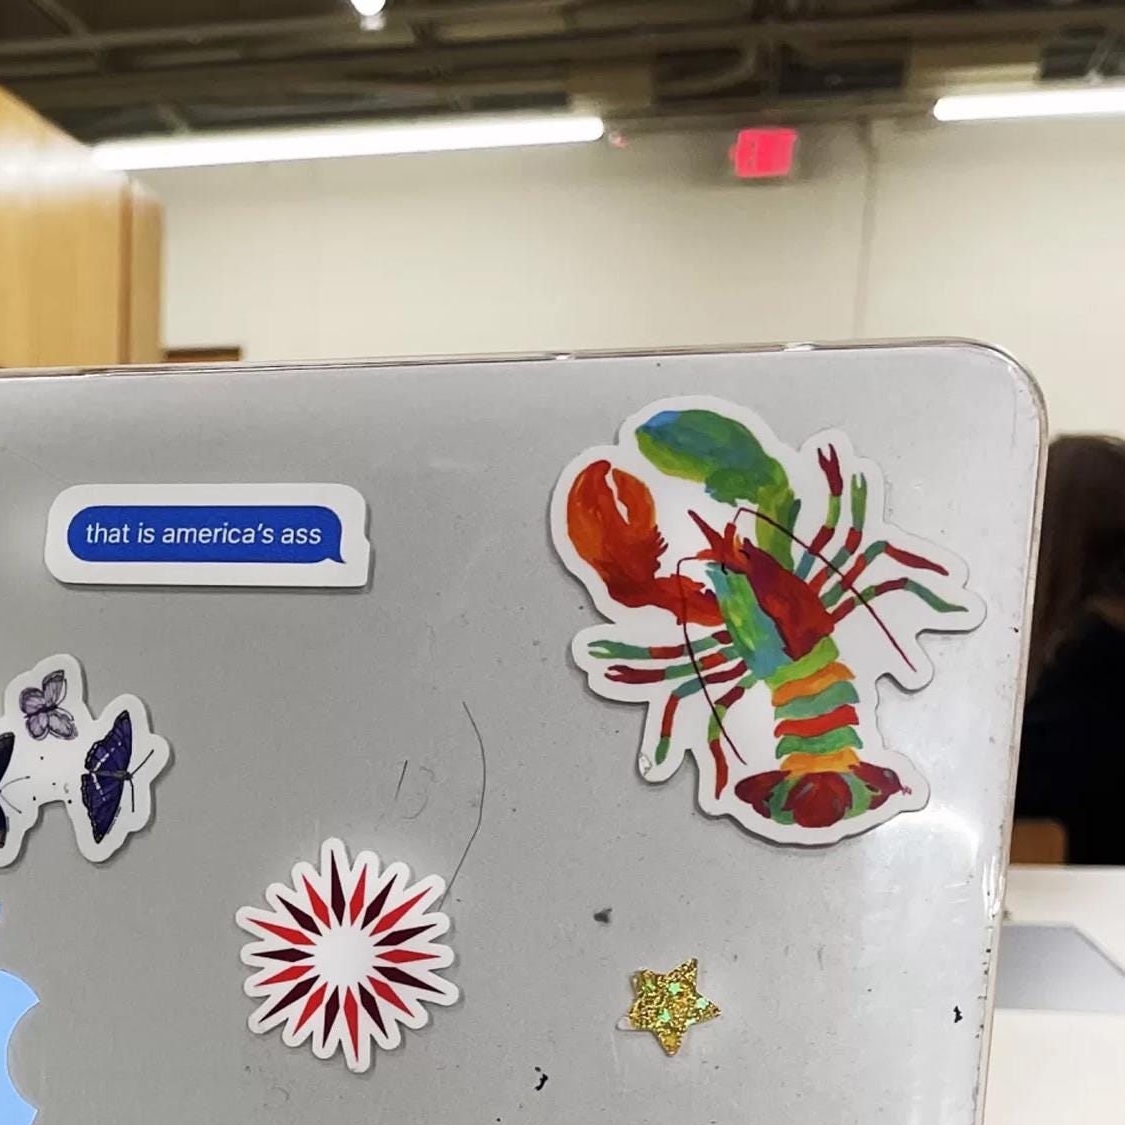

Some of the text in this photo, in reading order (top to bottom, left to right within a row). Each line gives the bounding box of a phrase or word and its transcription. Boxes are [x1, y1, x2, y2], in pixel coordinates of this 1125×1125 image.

[85, 522, 322, 545] that is america's ass
